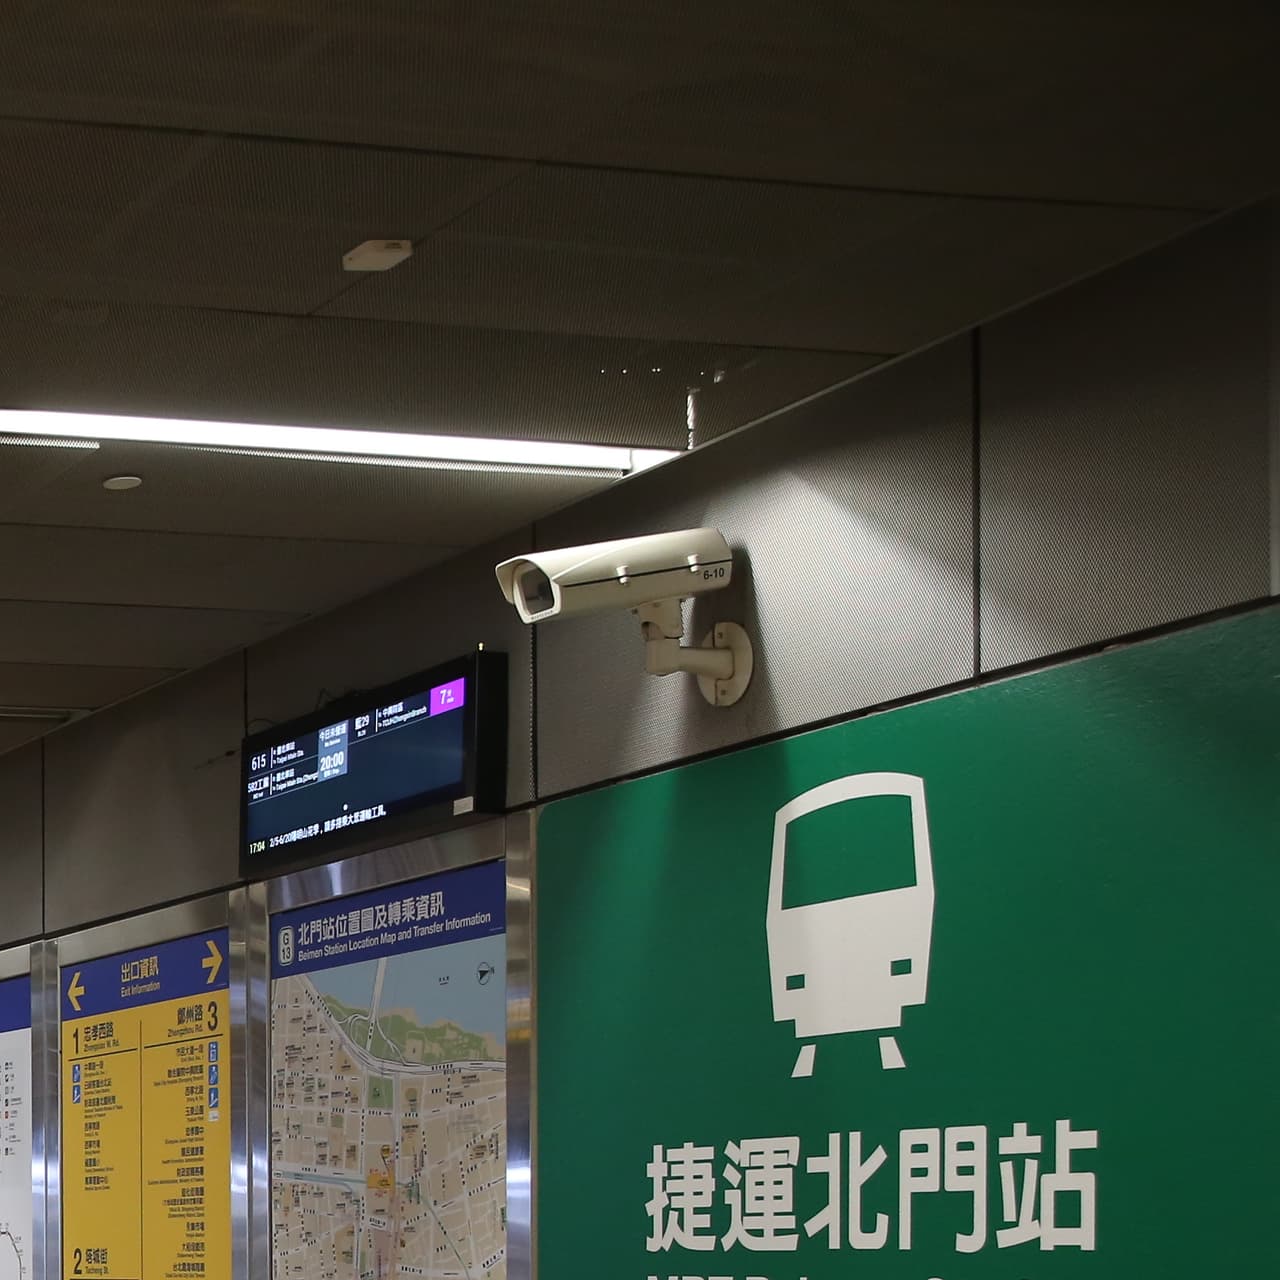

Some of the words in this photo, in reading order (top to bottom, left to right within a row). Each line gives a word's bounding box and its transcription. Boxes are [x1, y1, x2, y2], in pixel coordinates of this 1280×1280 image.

[703, 567, 725, 580] 6-10
[440, 689, 447, 704] 7
[251, 754, 266, 771] 615
[320, 751, 344, 771] 20:00
[249, 840, 266, 855] 17:04
[297, 891, 445, 945] 北門站位置圖及轉乘資訊
[282, 934, 290, 945] G
[297, 948, 323, 962] Beimen
[323, 943, 348, 957] Station
[348, 935, 380, 952] Location
[380, 932, 397, 947] Map
[397, 927, 412, 941] and
[413, 921, 444, 938] Transfer
[444, 911, 491, 932] Information
[281, 947, 292, 961] 13
[121, 956, 159, 982] 出口資訊
[121, 986, 131, 997] Exit
[131, 982, 160, 995] Information
[207, 1001, 218, 1031] 3
[73, 1028, 79, 1054] 1
[644, 1118, 1099, 1254] 捷運北門站
[73, 1248, 82, 1275] 2
